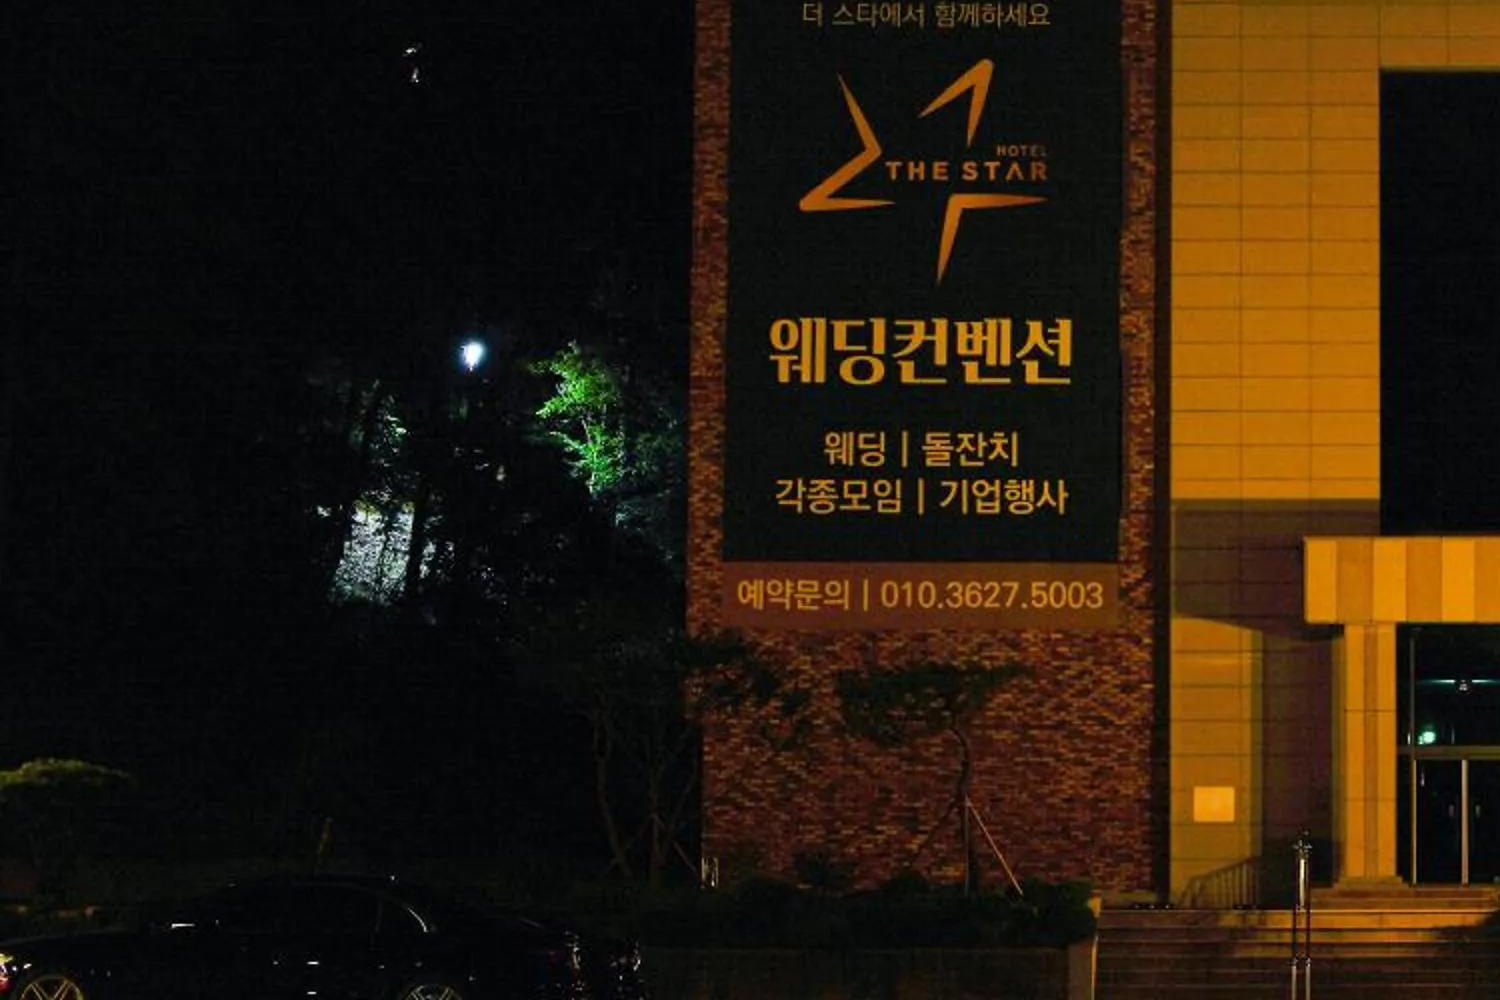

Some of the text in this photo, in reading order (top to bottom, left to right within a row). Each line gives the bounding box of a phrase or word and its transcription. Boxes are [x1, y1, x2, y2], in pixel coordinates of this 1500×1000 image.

[803, 2, 1051, 27] 더 스타에서 함께하세요
[997, 145, 1047, 157] HOTEL
[885, 161, 1047, 181] THE STAR
[769, 318, 1073, 385] 웨딩컨벤션
[825, 430, 1019, 468] 웨딩 돌잔치
[775, 479, 1069, 515] 각종모임 기업행사
[737, 579, 1104, 611] 예약문의 010.3627.5003
